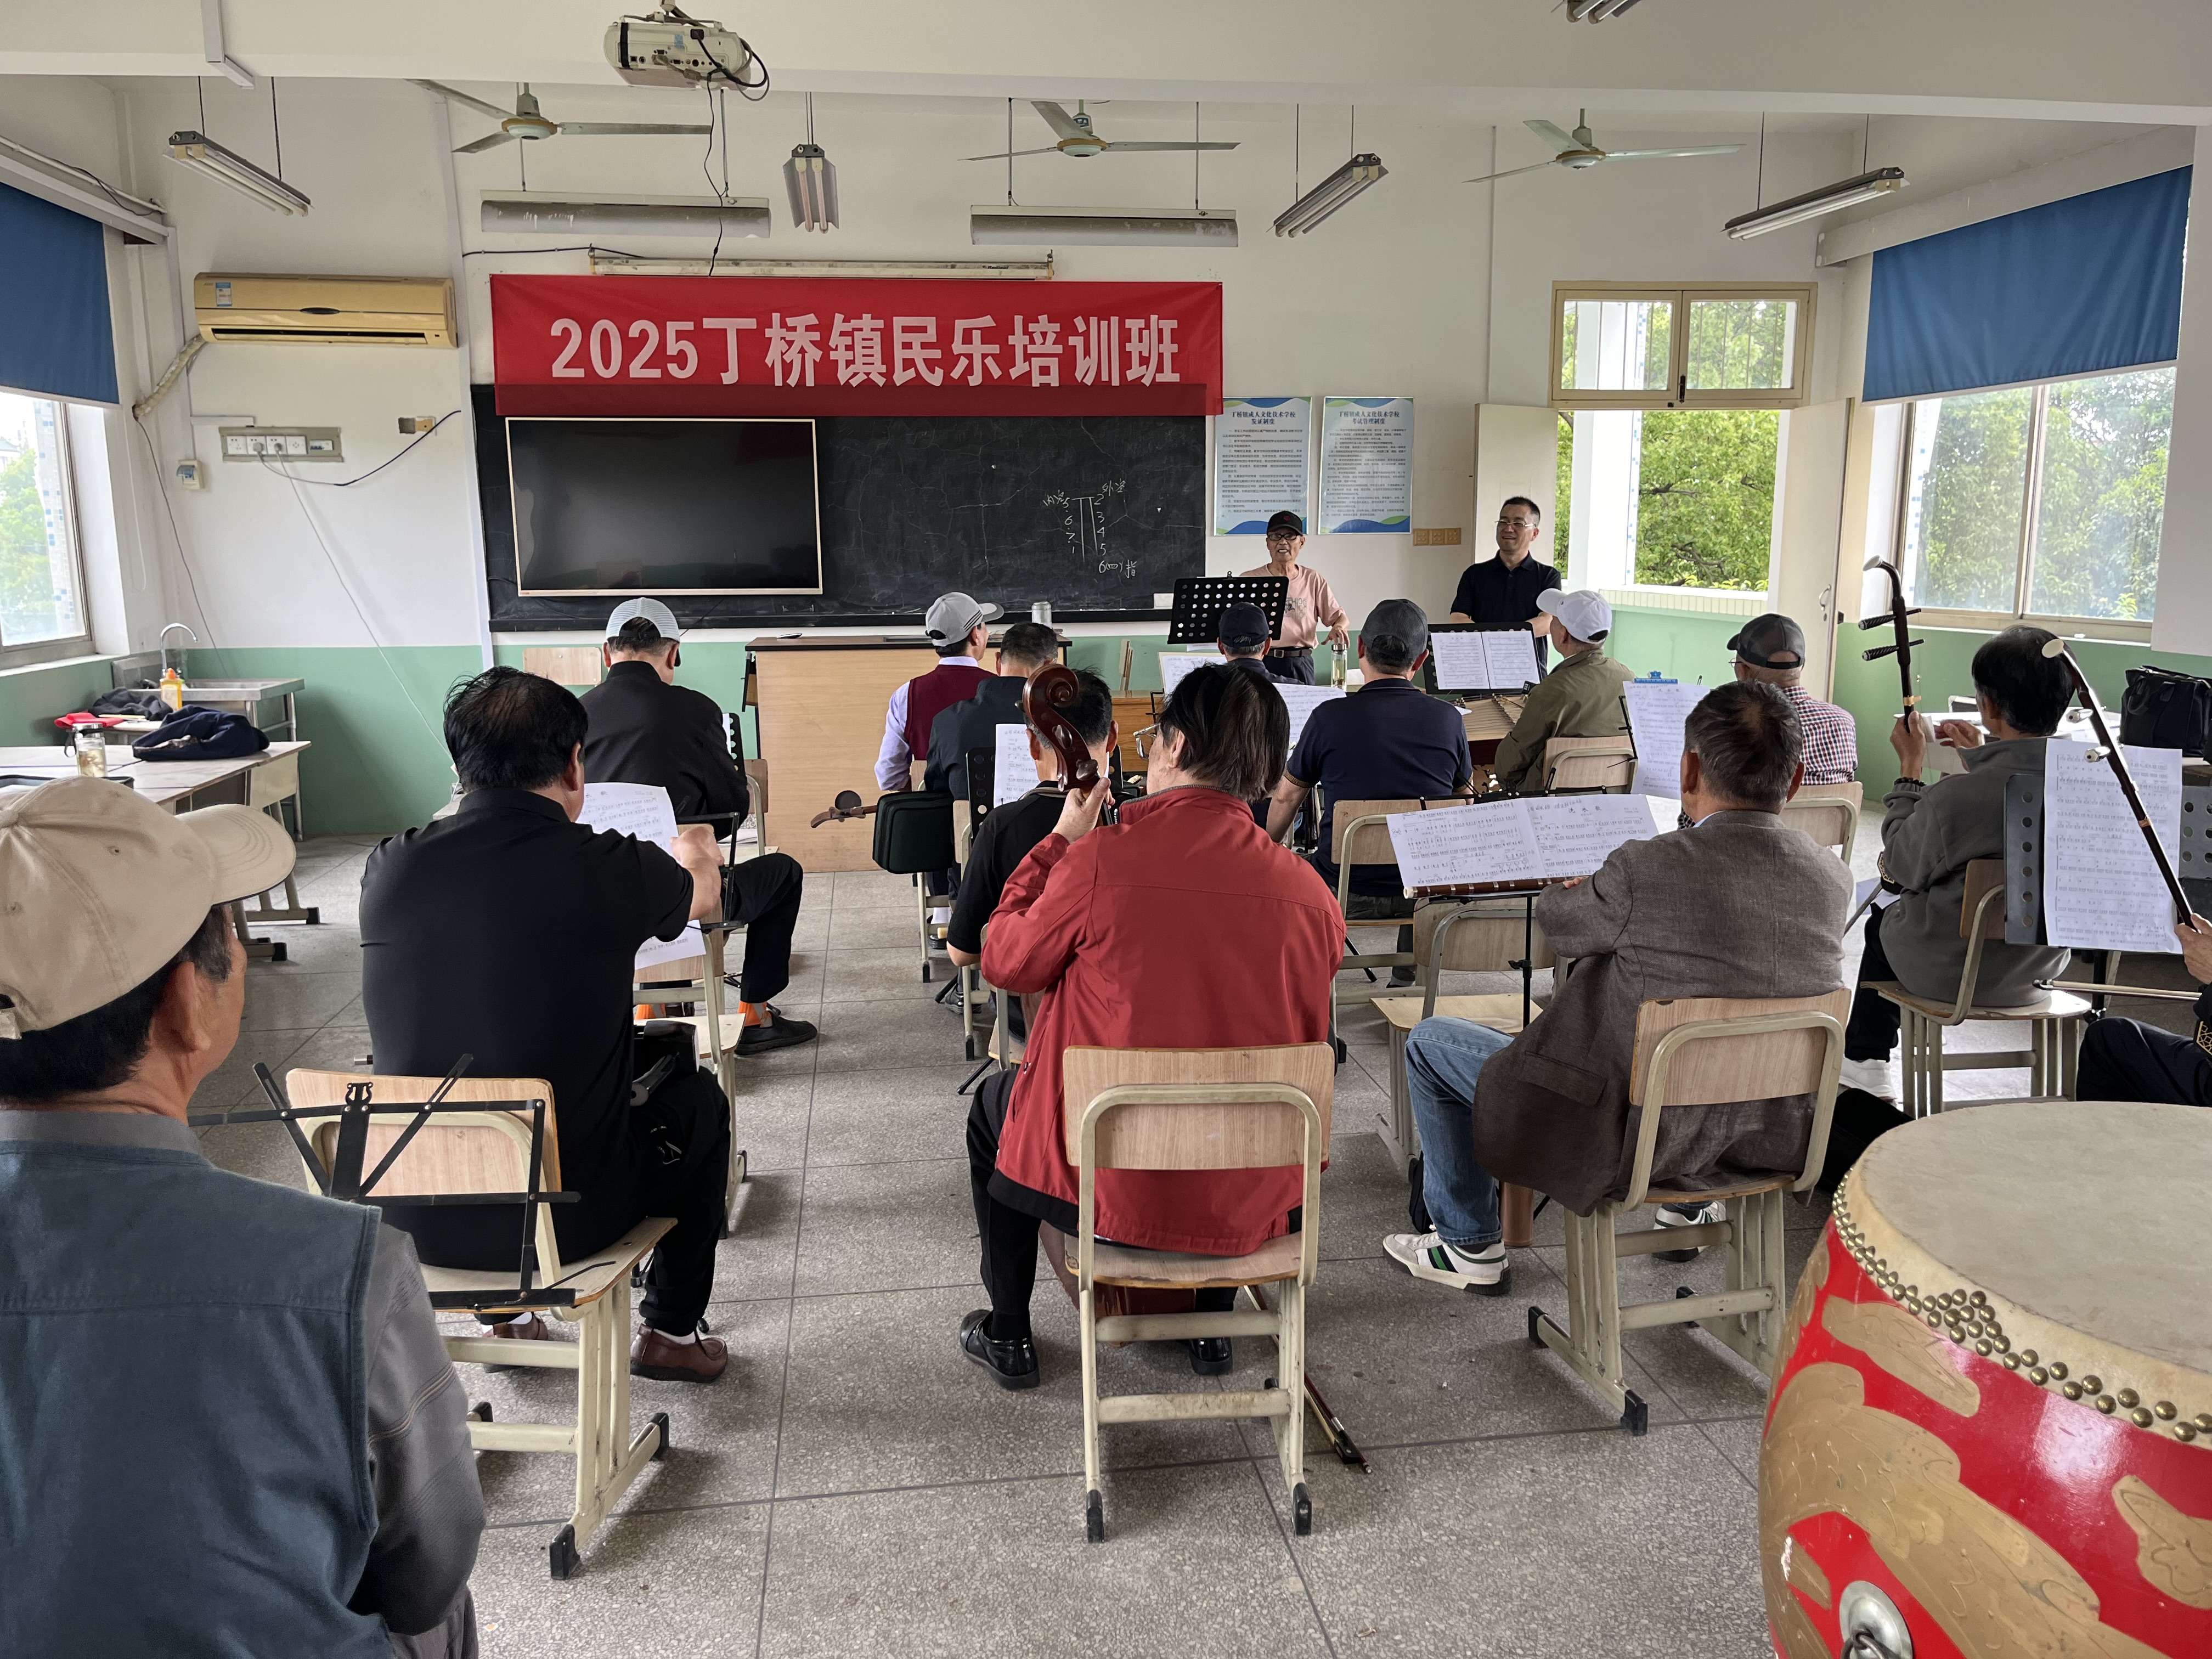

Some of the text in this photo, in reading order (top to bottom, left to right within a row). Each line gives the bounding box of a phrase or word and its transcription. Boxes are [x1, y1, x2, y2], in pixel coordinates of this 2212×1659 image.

[550, 312, 1180, 387] 2025丁桥镇民乐培训班
[1094, 494, 1104, 505] 2
[1097, 511, 1104, 523] 3
[1097, 527, 1104, 537] 4
[1100, 543, 1107, 555] 5
